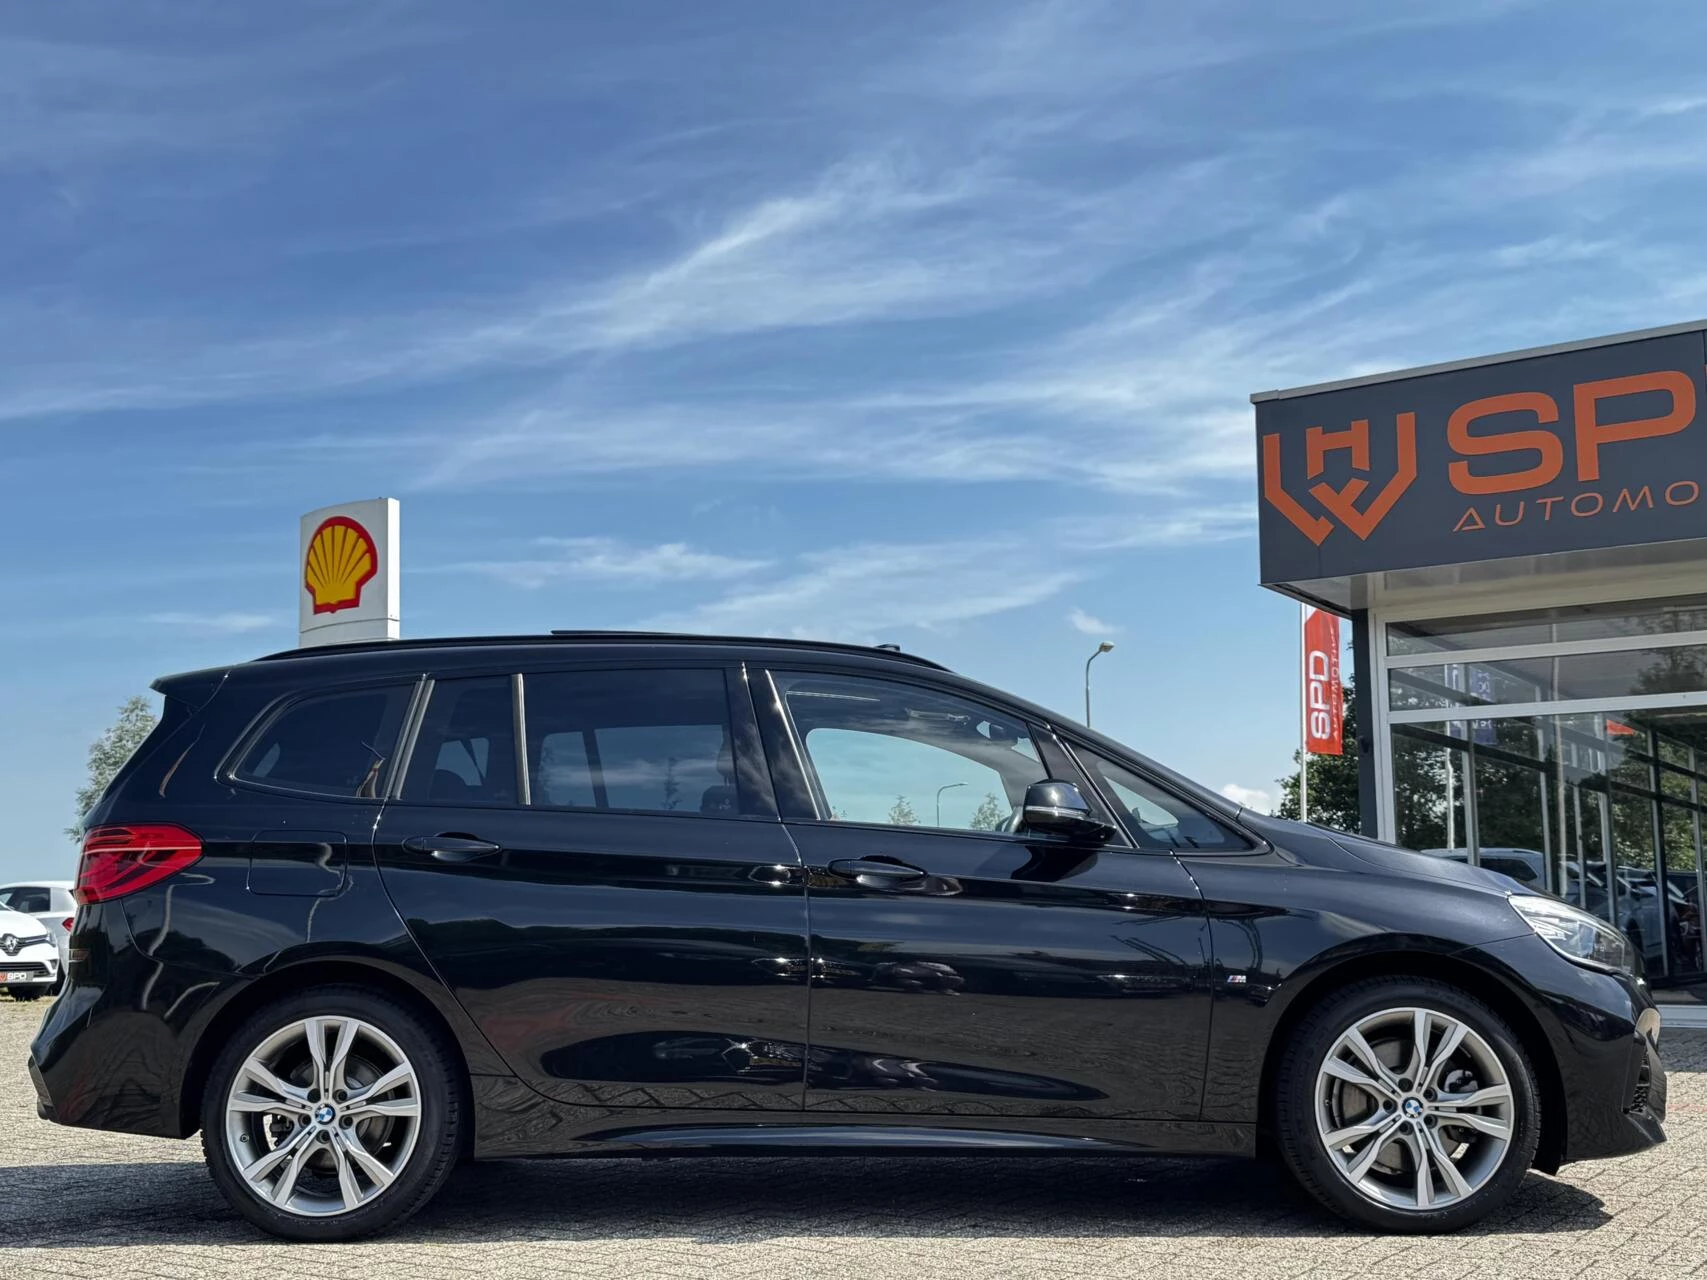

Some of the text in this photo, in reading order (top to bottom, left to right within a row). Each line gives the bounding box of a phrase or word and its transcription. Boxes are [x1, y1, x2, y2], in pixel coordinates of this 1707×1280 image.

[1447, 370, 1707, 495] SP
[1452, 481, 1699, 532] AUTOMO
[1309, 650, 1330, 739] SPD
